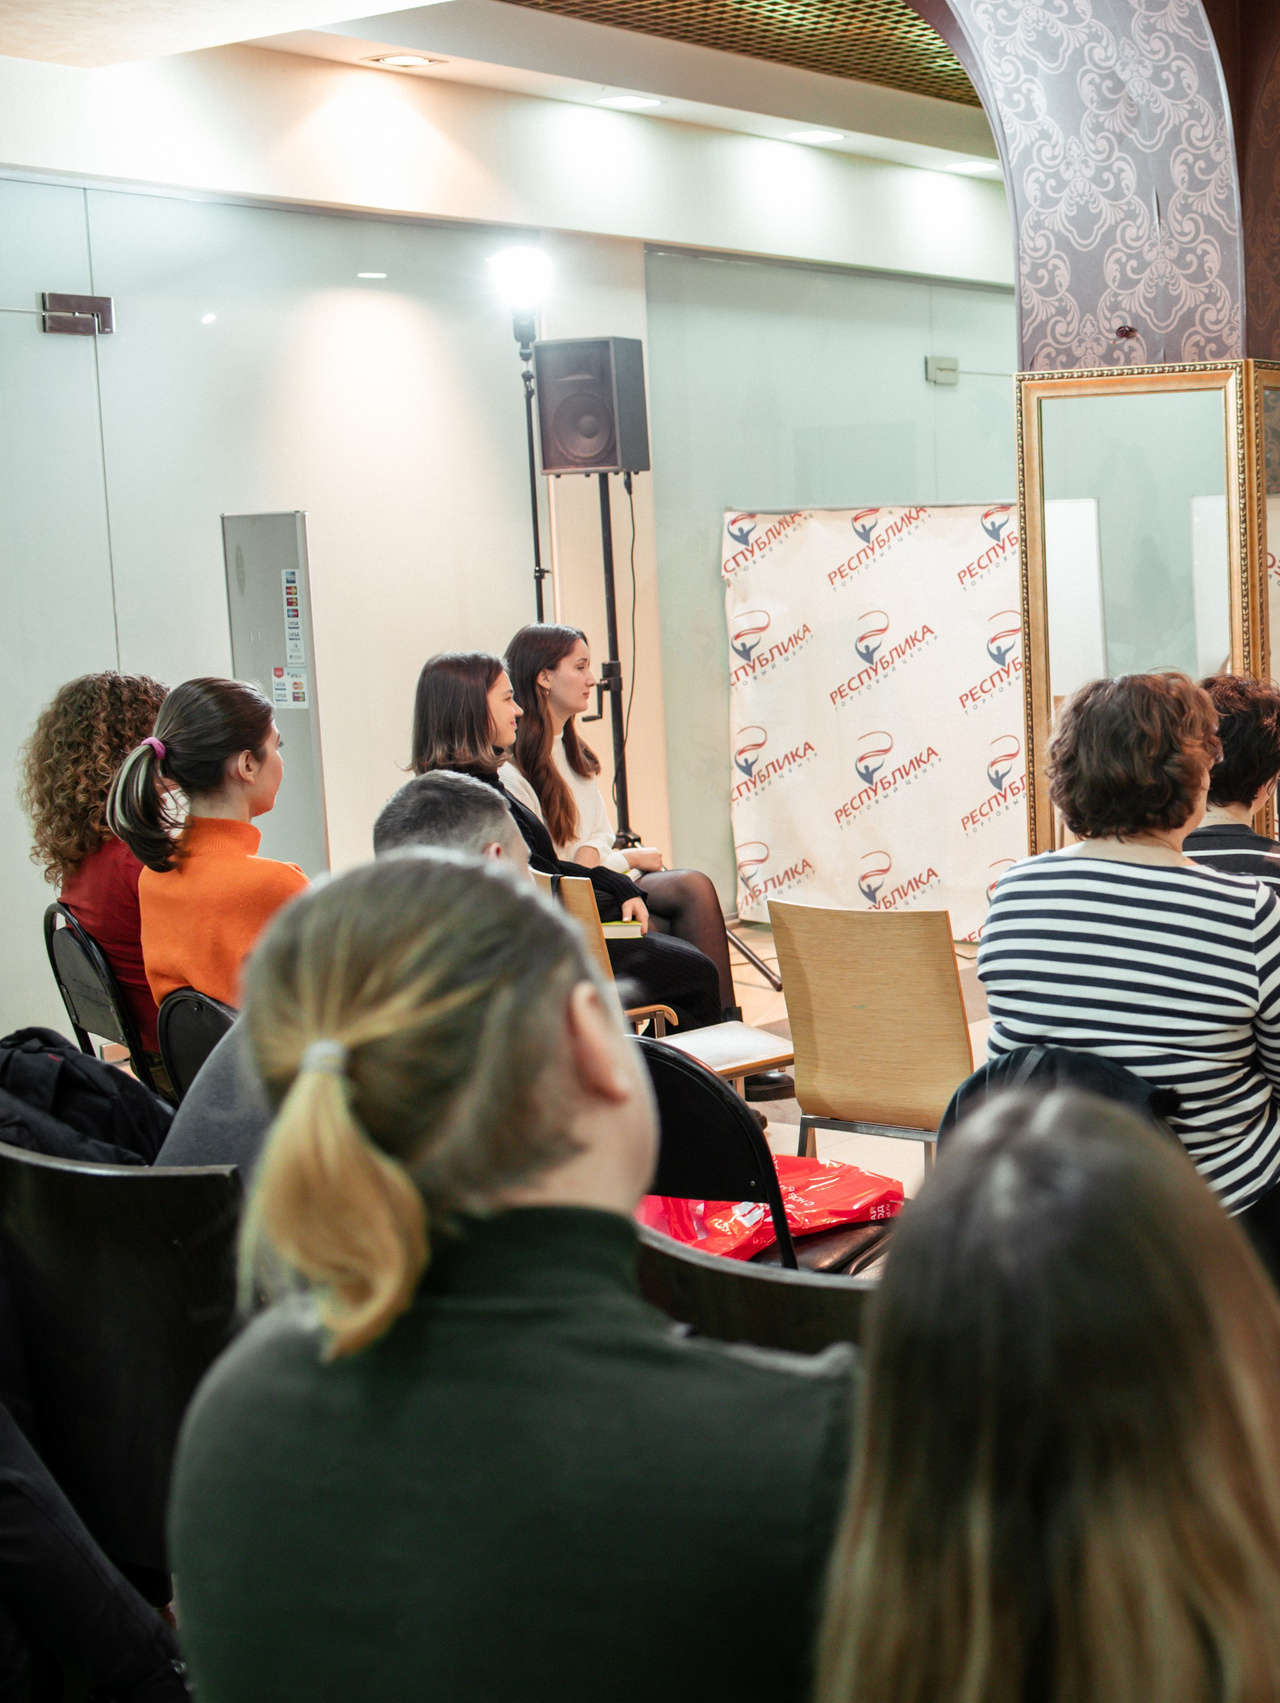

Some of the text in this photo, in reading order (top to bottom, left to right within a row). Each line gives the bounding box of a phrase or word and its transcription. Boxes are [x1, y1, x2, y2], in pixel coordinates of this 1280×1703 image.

[957, 531, 1019, 585] РЕСПУБ
[963, 549, 1017, 592] ТОРГОВЫ
[829, 624, 935, 705] РЕСПУБЛИКА
[959, 657, 1023, 709] РЕСПУБ
[964, 674, 1020, 715] ТОРГОВЫ
[834, 746, 939, 824] РЕСПУБЛИКА
